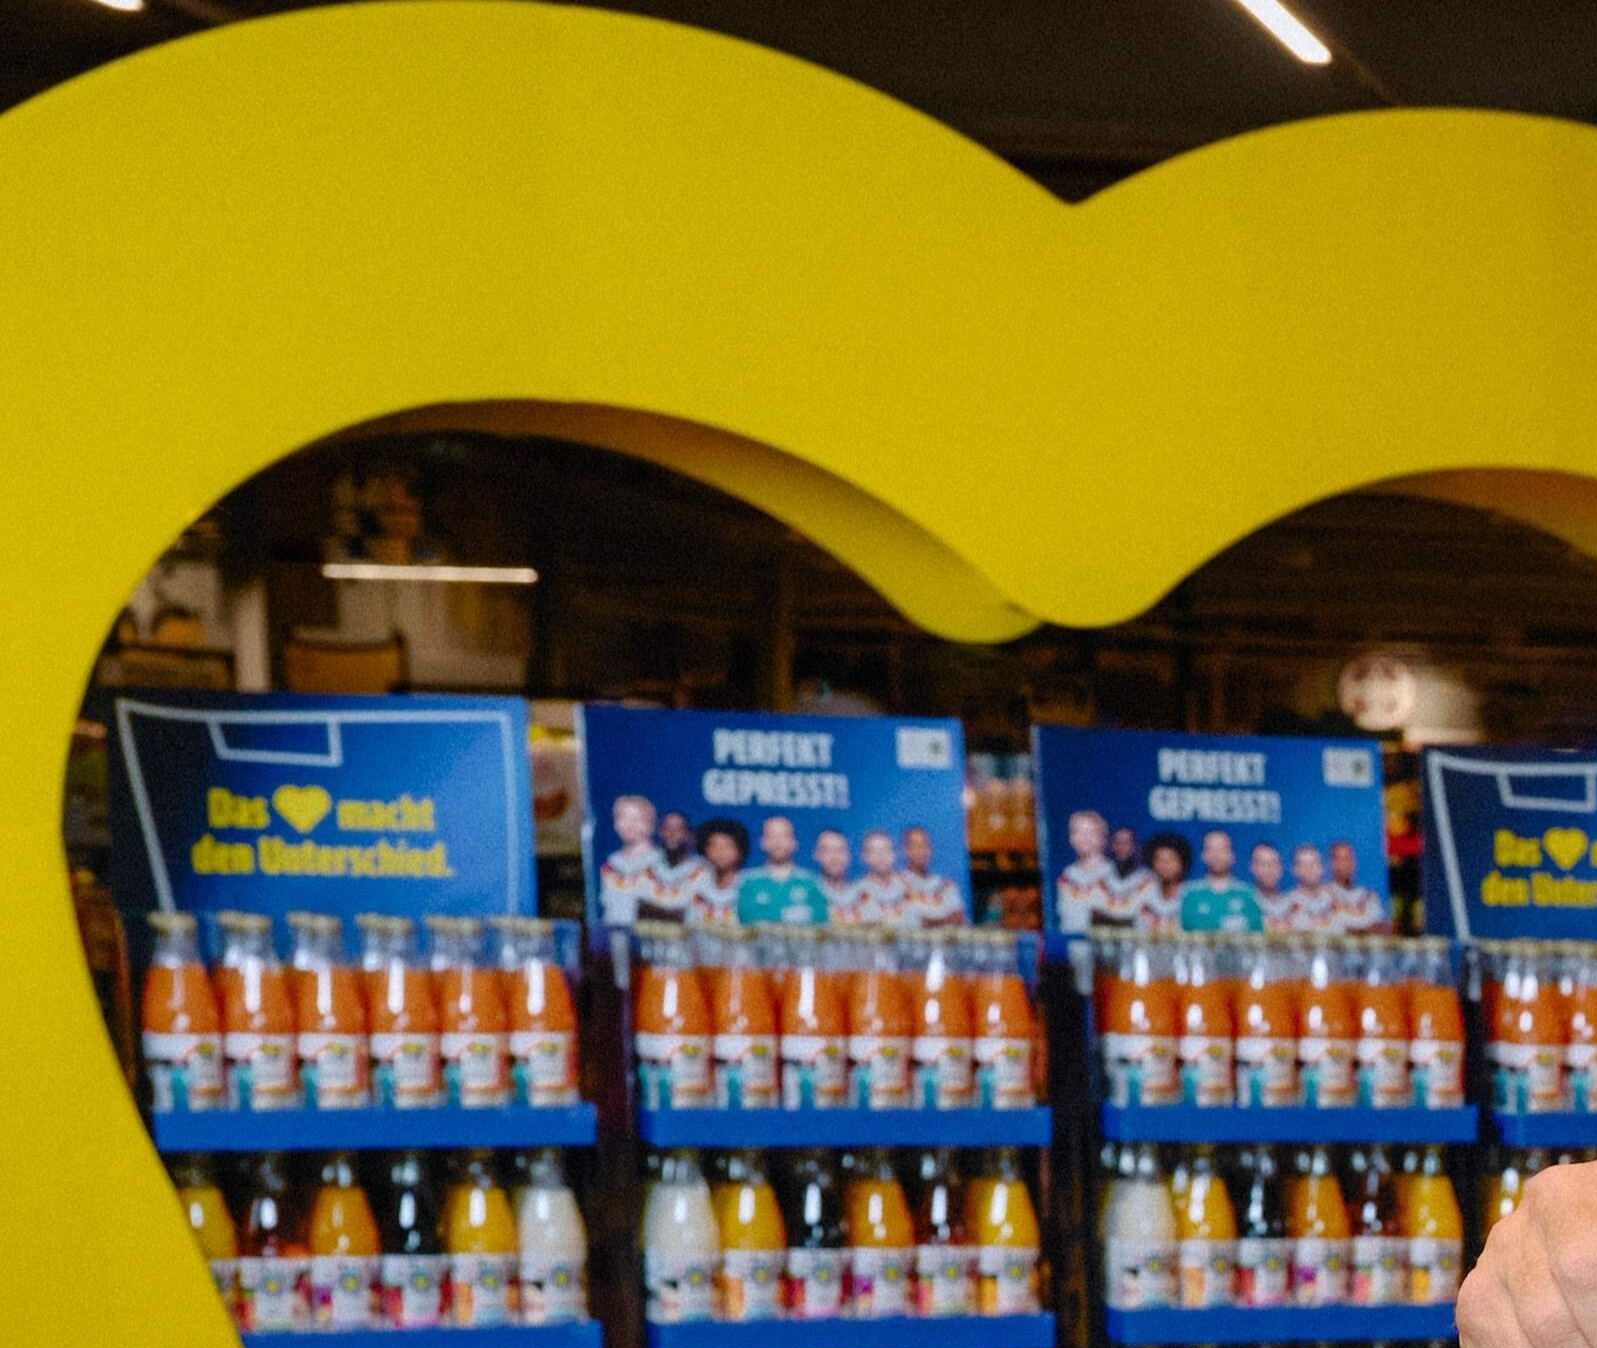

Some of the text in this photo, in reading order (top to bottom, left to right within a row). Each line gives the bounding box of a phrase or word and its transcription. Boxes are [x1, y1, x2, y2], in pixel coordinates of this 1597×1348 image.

[713, 728, 833, 768] PERFEKT
[1157, 748, 1267, 786] PERFEKT
[206, 786, 435, 831] Das macht
[191, 834, 255, 875] den
[1493, 829, 1542, 867] Das
[1481, 870, 1530, 906] den
